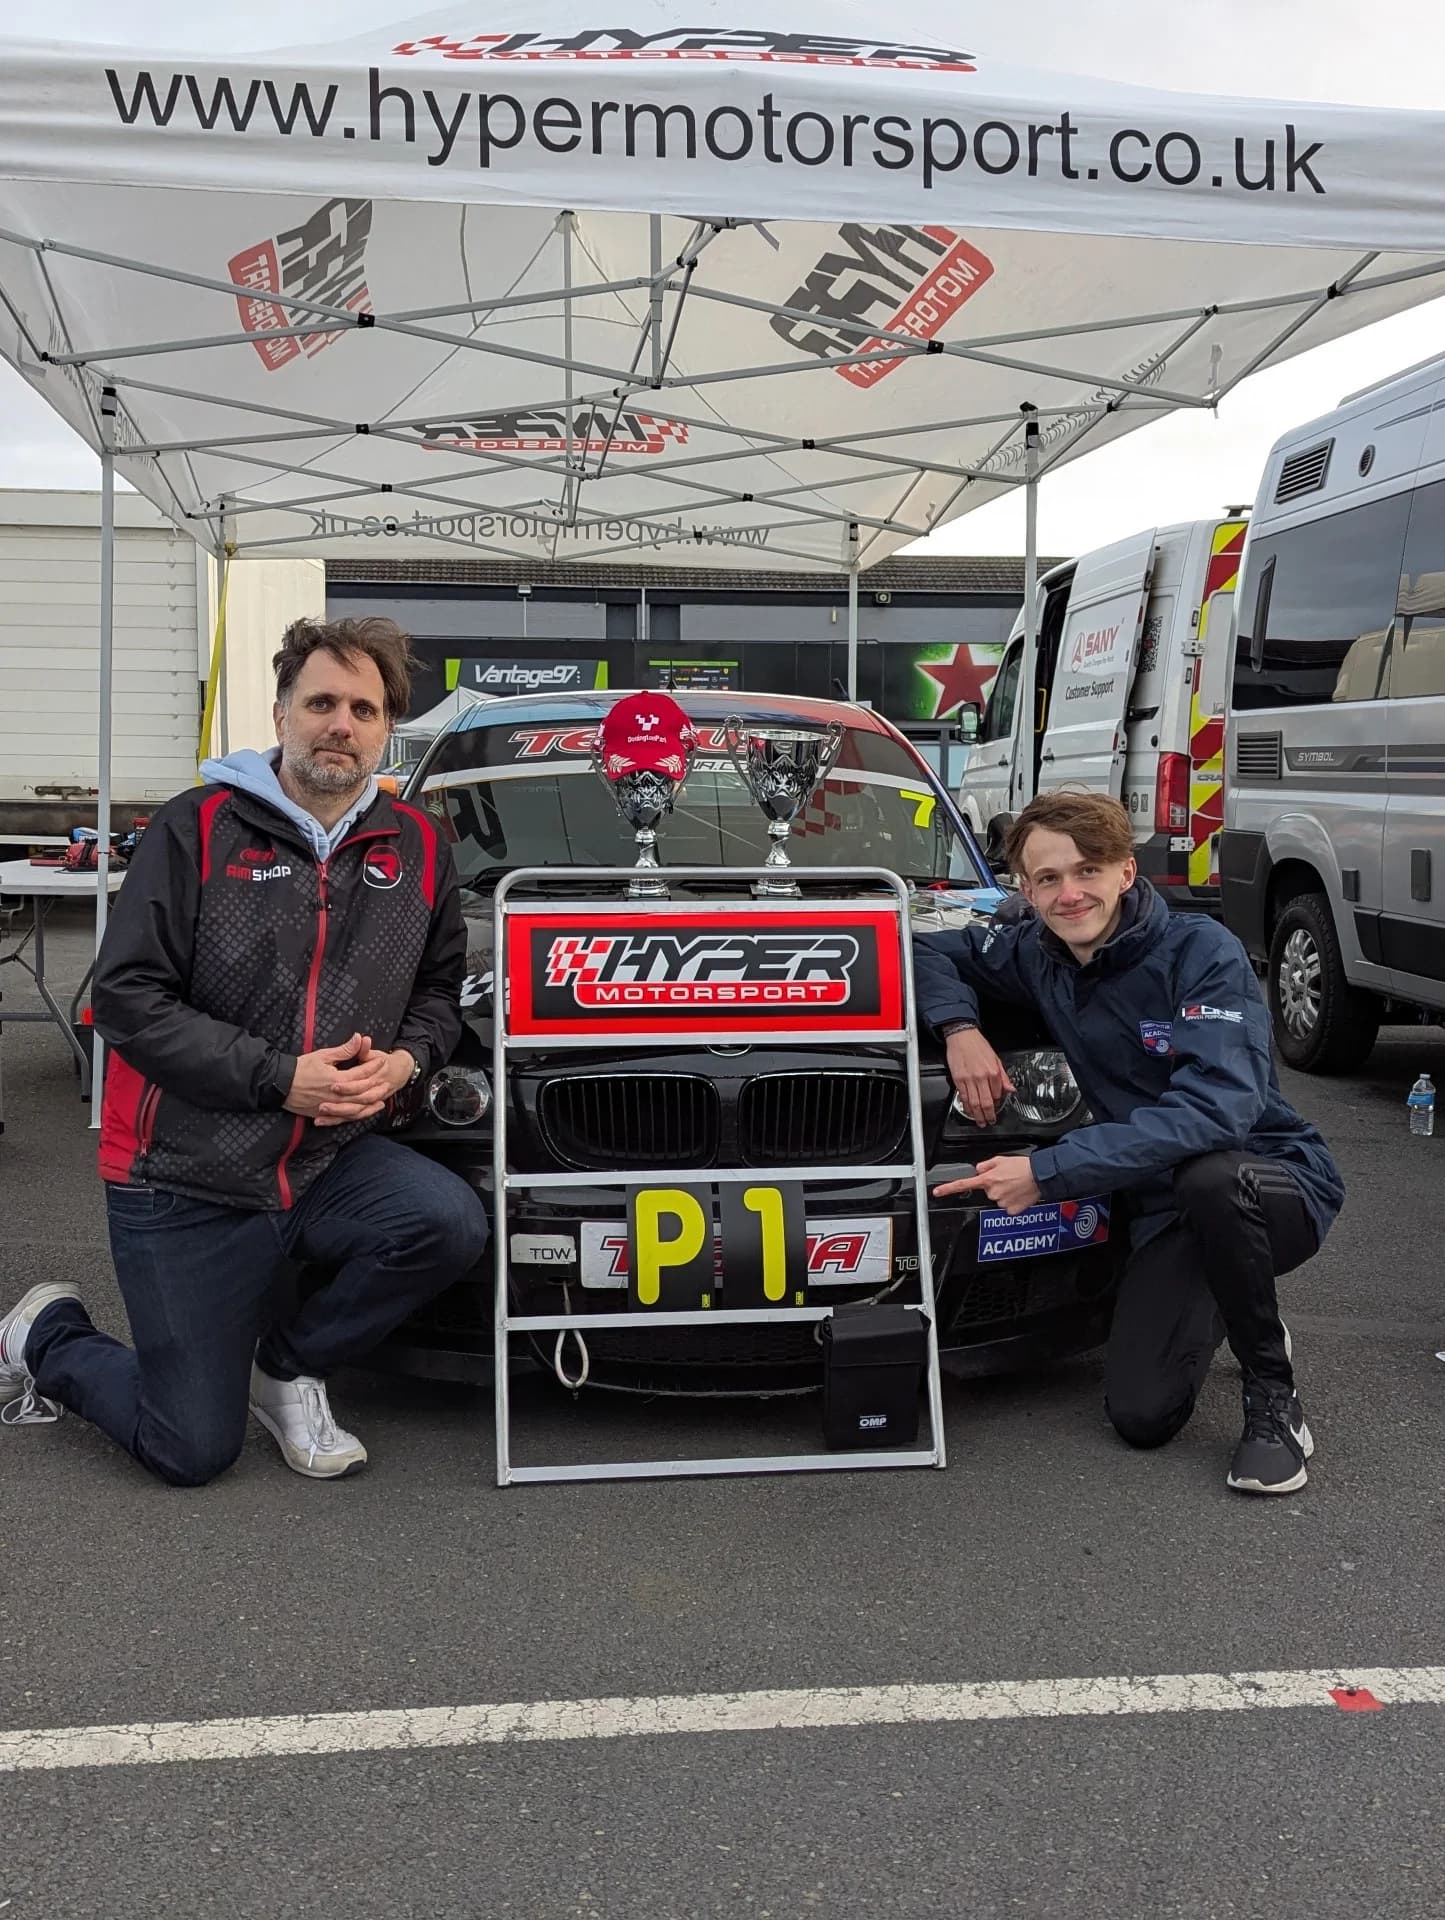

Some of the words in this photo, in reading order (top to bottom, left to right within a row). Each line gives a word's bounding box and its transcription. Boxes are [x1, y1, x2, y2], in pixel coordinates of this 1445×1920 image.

[487, 27, 977, 64] HYPER
[482, 50, 941, 69] MOTORSPORT
[104, 67, 1327, 195] www.hypermotorsport.co.uk
[1085, 625, 1120, 657] SANY
[1065, 685, 1091, 701] Customer
[1091, 678, 1115, 699] Support
[1297, 751, 1335, 762] SYMBOL
[899, 789, 937, 829] 7
[598, 937, 857, 983] HYPER
[595, 985, 829, 1001] MOTORSPORT
[983, 1212, 1043, 1229] motorsport
[529, 1247, 572, 1261] TOW
[982, 1233, 1057, 1256] ACADEMY
[859, 1417, 887, 1427] OMP
